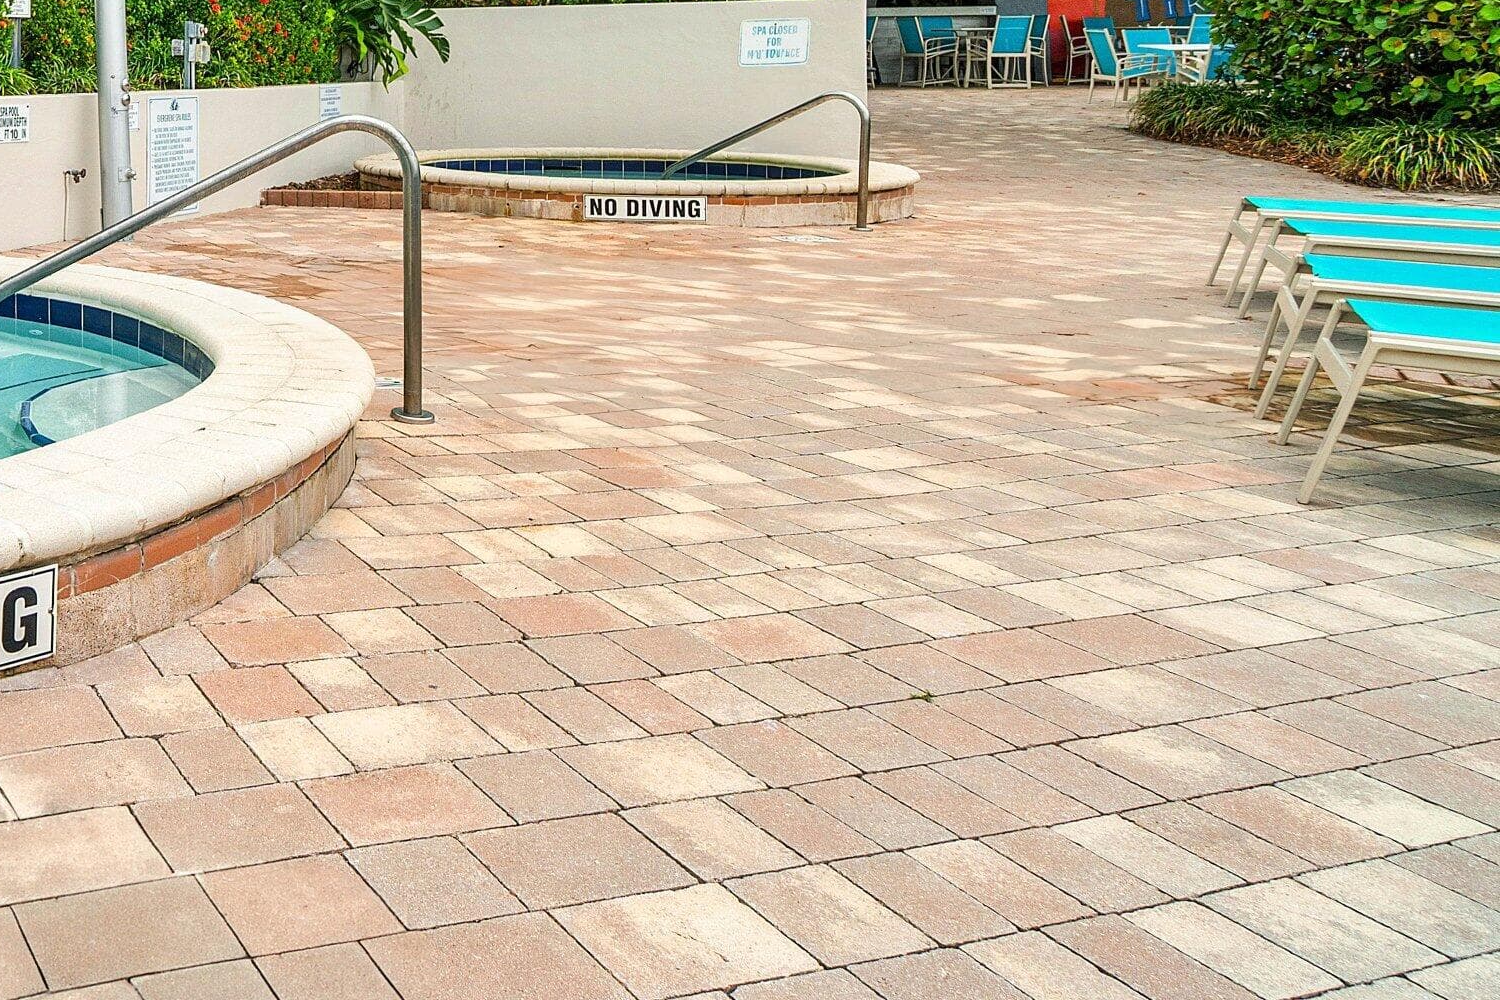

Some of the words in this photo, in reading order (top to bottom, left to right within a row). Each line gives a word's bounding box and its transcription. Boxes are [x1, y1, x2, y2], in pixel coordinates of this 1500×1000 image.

[752, 26, 766, 35] SPA
[769, 26, 798, 35] CLOSED
[767, 38, 781, 46] FOR
[0, 106, 8, 117] SPA
[9, 106, 20, 117] POOL
[14, 116, 28, 127] DEPTH
[4, 129, 10, 140] FT
[10, 129, 19, 139] 10
[590, 198, 617, 216] NO
[626, 199, 701, 218] DIVING
